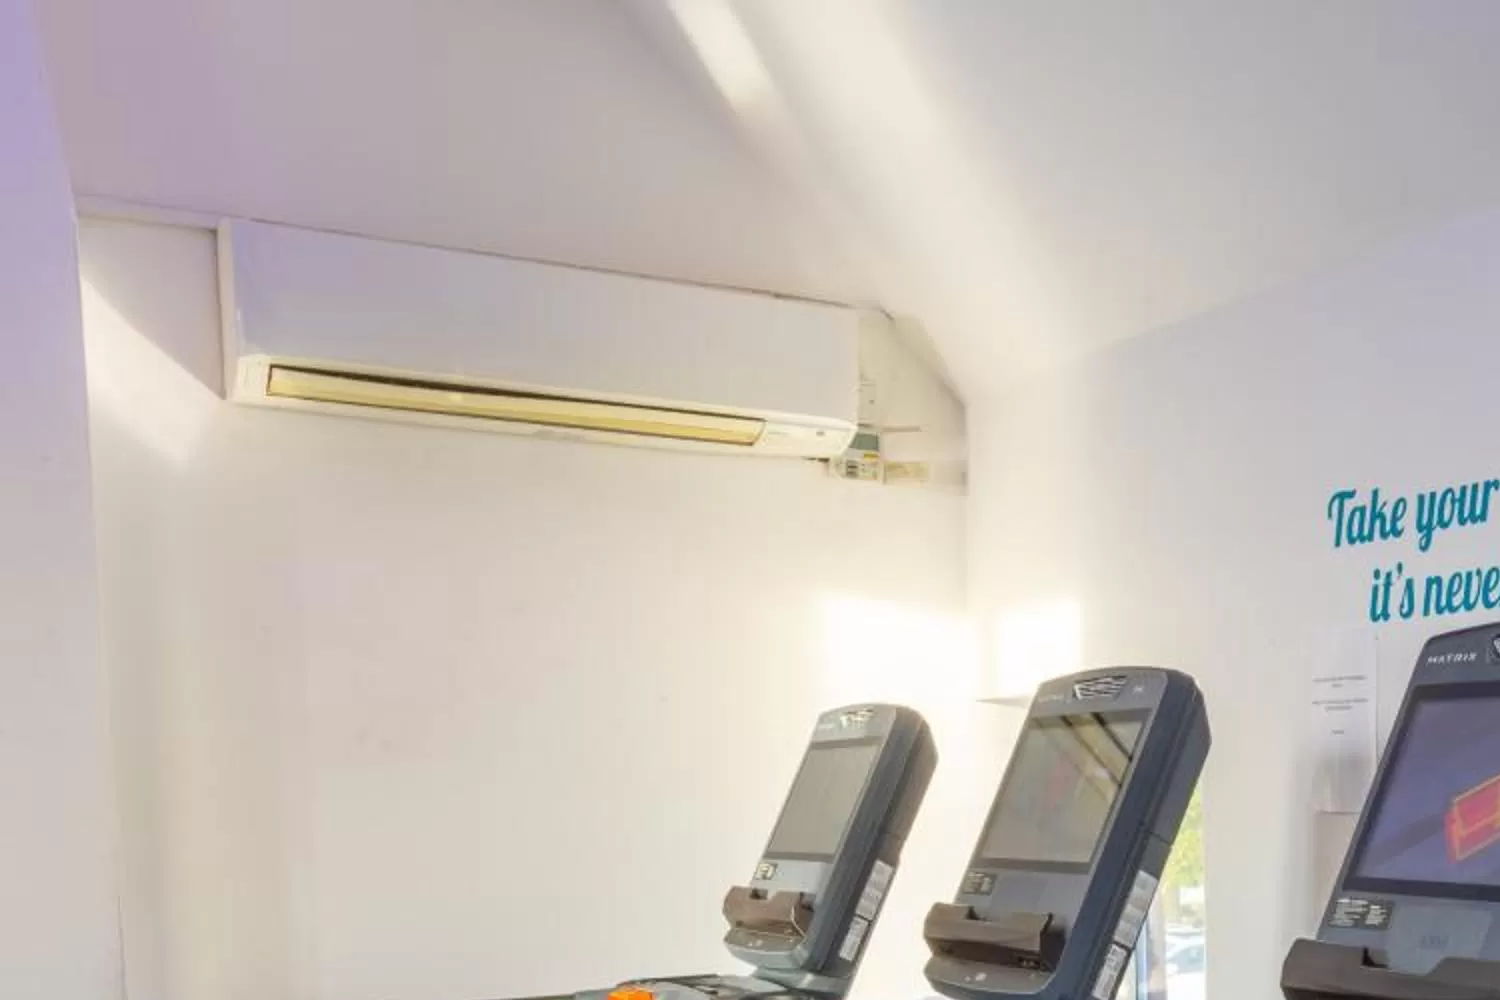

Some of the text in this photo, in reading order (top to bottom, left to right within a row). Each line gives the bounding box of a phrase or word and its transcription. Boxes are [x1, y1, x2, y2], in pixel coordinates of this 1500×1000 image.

[1327, 488, 1407, 548] Take
[1415, 479, 1500, 552] your
[1369, 562, 1415, 623] it's
